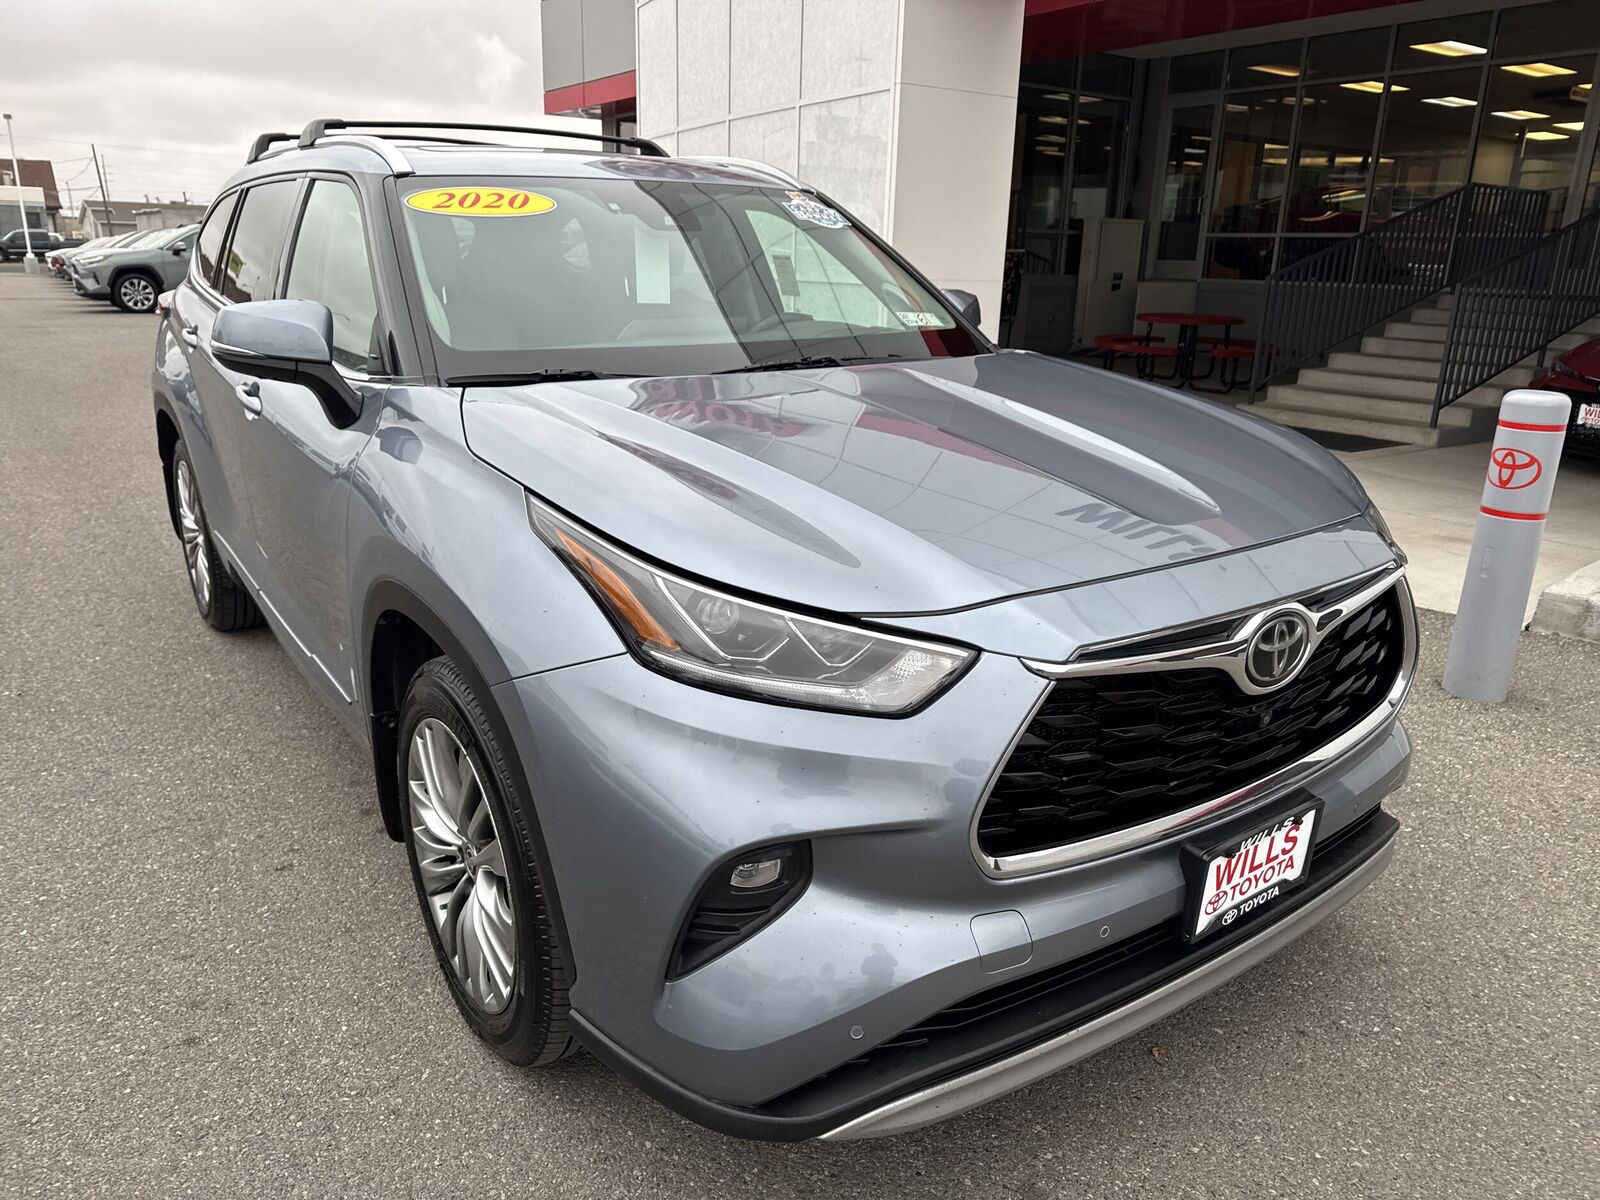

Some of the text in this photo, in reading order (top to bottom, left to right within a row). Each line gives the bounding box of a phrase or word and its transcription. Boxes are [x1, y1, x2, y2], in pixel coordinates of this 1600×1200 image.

[431, 191, 530, 210] 2020
[1215, 824, 1300, 892] WILLS
[1230, 854, 1295, 902] TOYOTA
[1240, 885, 1280, 916] TOYOTA
